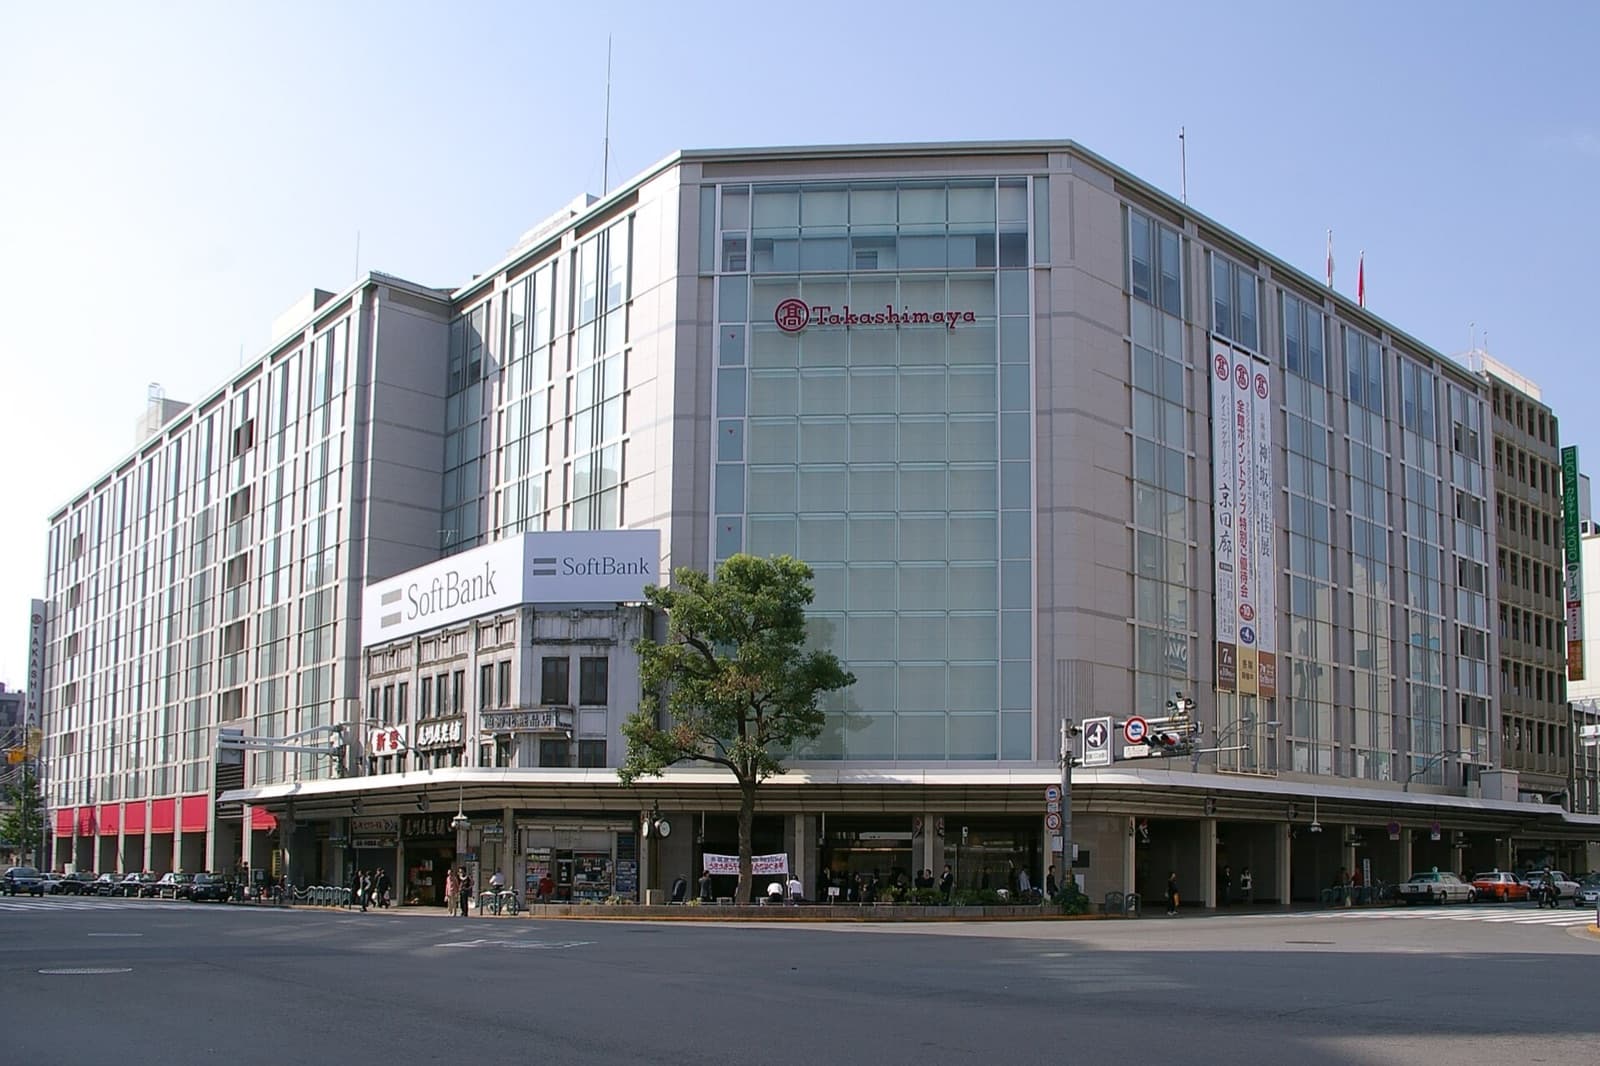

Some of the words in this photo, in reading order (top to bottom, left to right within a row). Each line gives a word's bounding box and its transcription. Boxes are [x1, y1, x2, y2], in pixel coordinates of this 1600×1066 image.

[812, 304, 976, 328] Takashimaya
[1567, 526, 1577, 560] KYOTO
[562, 557, 650, 576] SoftBank
[407, 561, 497, 621] SoftBank
